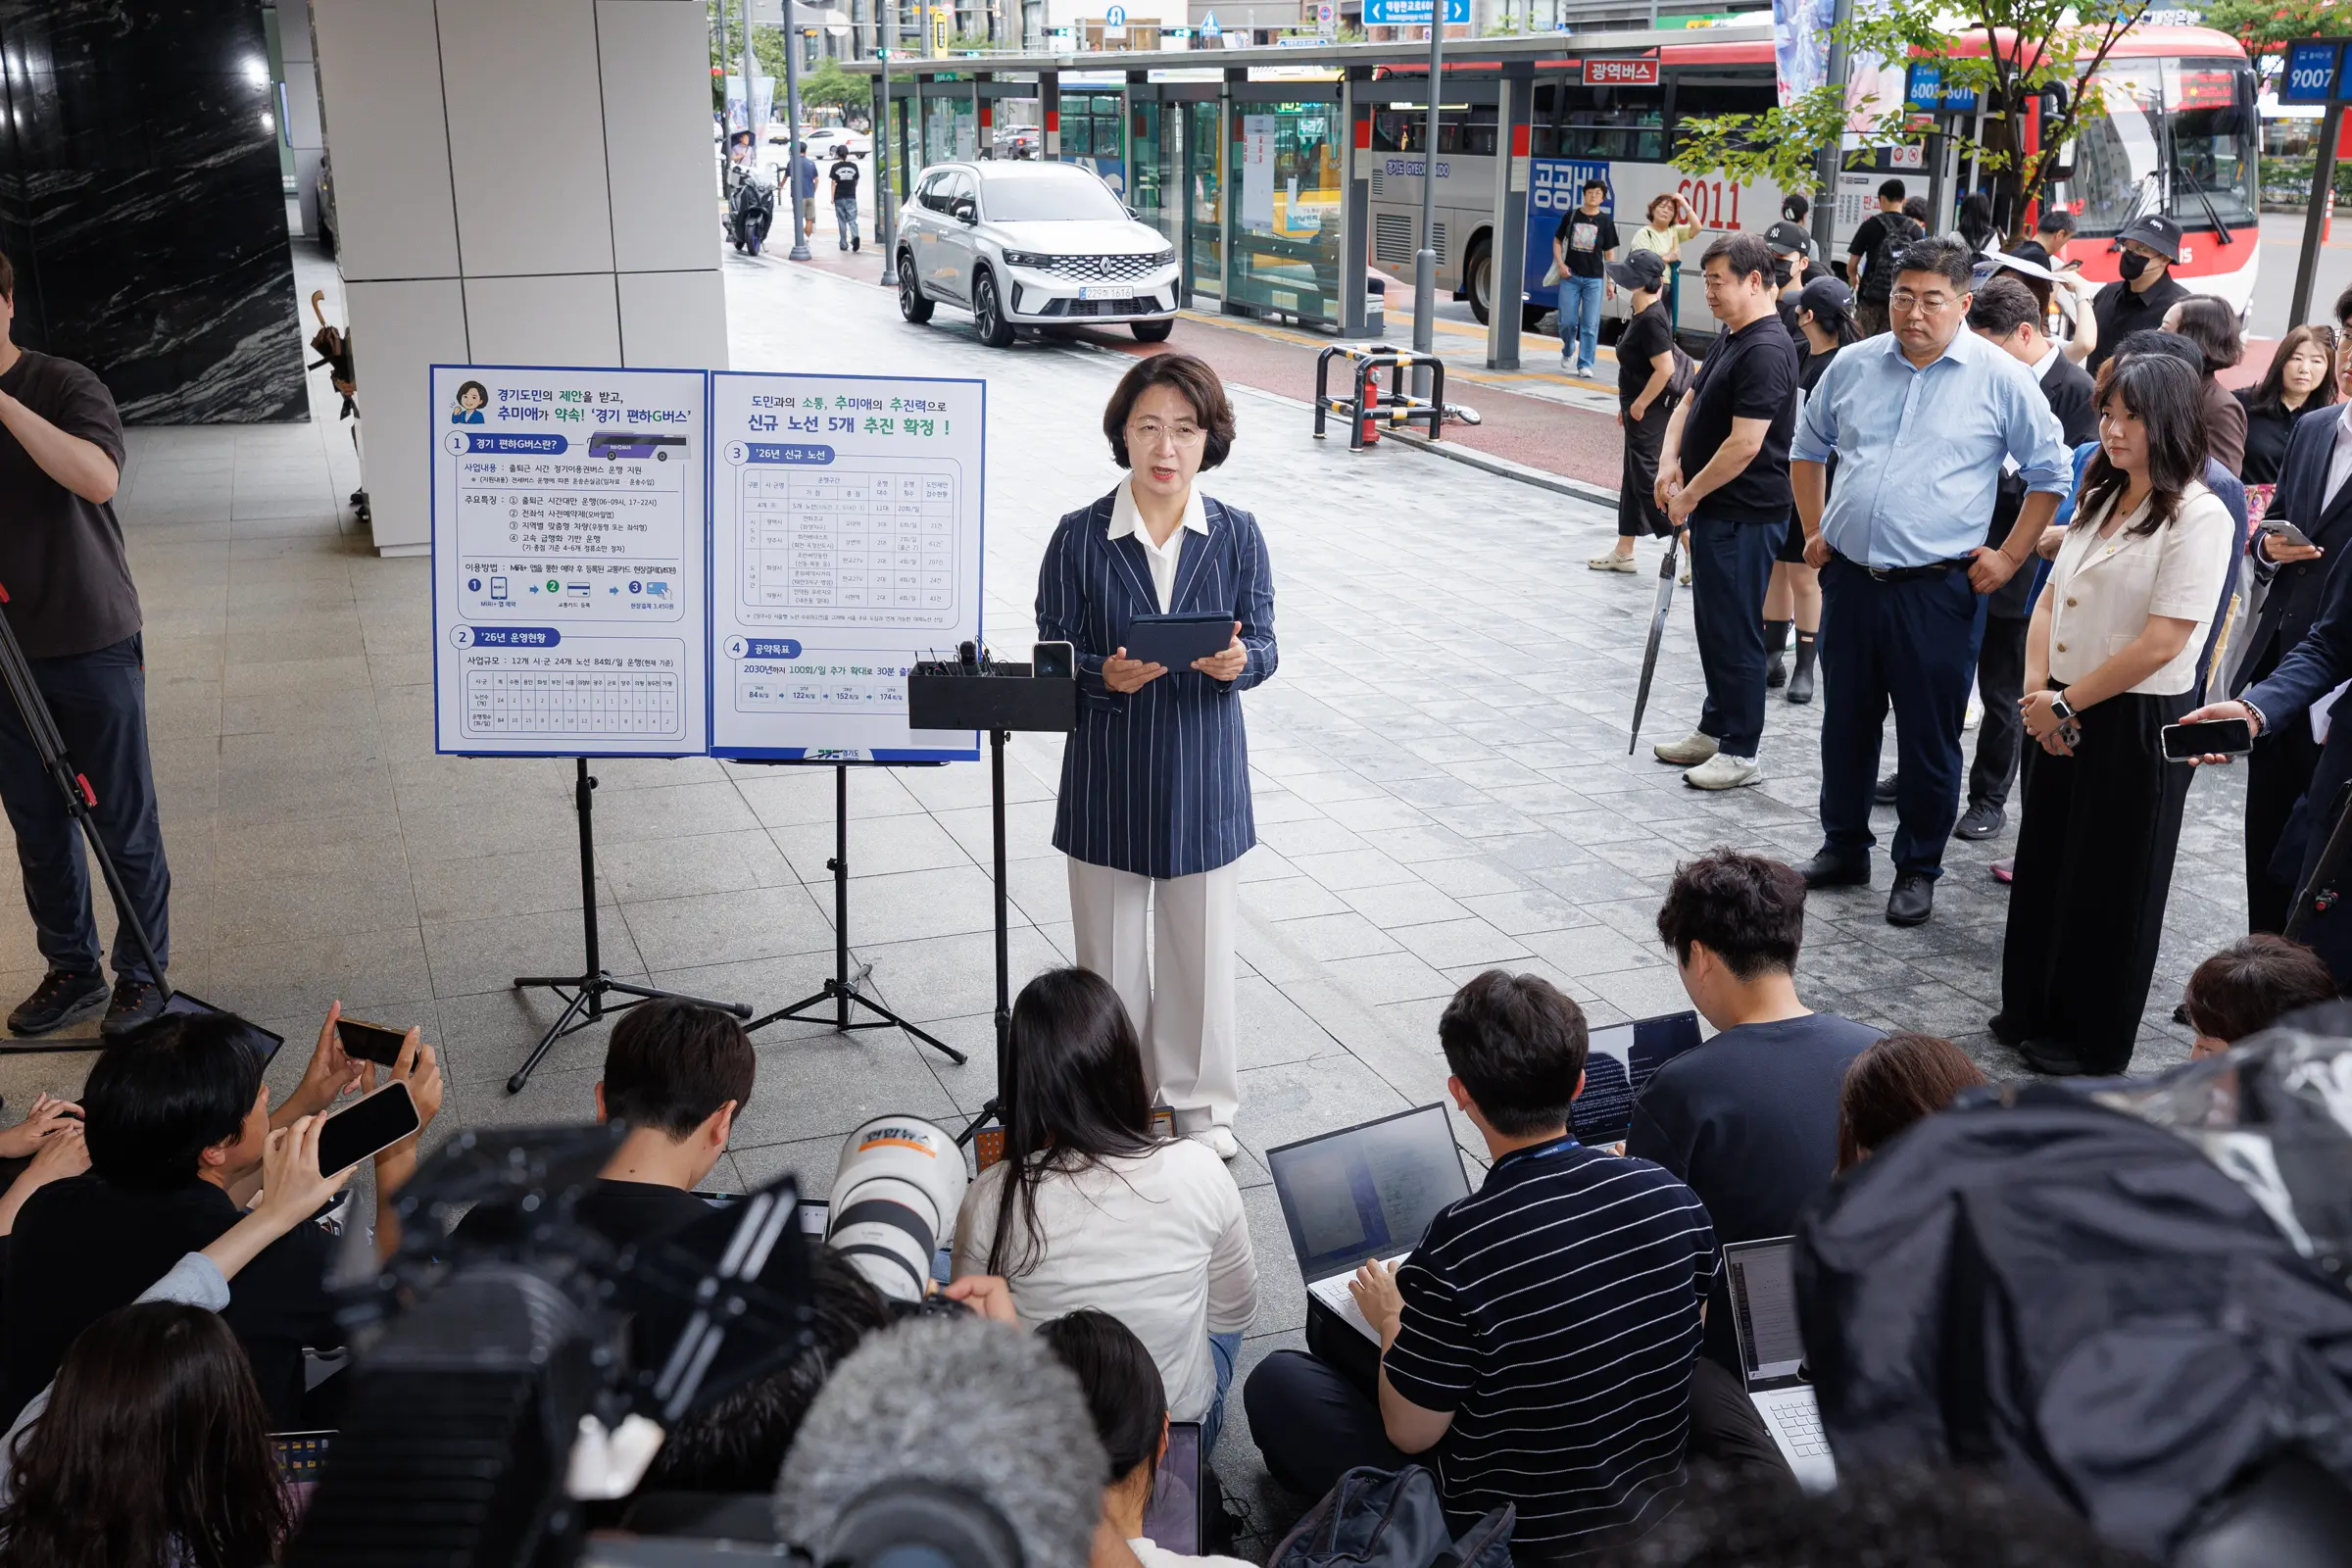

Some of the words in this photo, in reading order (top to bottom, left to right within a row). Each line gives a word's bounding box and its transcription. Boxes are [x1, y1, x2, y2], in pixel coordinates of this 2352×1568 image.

[1592, 63, 1650, 80] 광역버스
[2291, 69, 2334, 88] 9007
[1387, 161, 1404, 175] 경기도
[1406, 162, 1449, 177] GYEOIDO
[1677, 179, 1740, 230] 6011
[1111, 288, 1131, 298] 1616
[498, 389, 553, 402] 경기도민의
[560, 390, 593, 403] 제안을
[600, 391, 623, 404] 받고,
[752, 396, 795, 408] 도민과의
[803, 397, 827, 410] 소통,
[835, 396, 882, 411] 추미애의
[890, 397, 947, 413] 추진력으로
[498, 407, 549, 421] 추미애가
[555, 408, 584, 422] 약속!
[748, 415, 778, 432] 신규
[788, 416, 818, 432] 노선
[828, 416, 855, 433] 5개
[863, 417, 894, 434] 추진
[904, 418, 934, 436] 확정
[945, 420, 949, 435] !
[455, 438, 461, 448] 1
[476, 439, 493, 449] 경기
[500, 439, 557, 450] 편하G버스란?
[733, 448, 740, 459] 3
[785, 450, 802, 459] 신규
[808, 451, 825, 460] 노선
[465, 464, 496, 472] 사업내용
[510, 465, 530, 473] 출퇴근
[535, 465, 549, 473] 시간
[555, 466, 604, 474] 정기이용권버스
[609, 466, 622, 474] 운행
[465, 496, 497, 505] 주요특징
[549, 497, 577, 506] 시간대만
[549, 510, 614, 518] 사전예약제(모바일앱)
[548, 522, 570, 531] 맞춤형
[522, 534, 536, 543] 고속
[466, 564, 497, 572] 이용방법
[546, 564, 558, 573] 통한
[472, 581, 477, 590] 1
[550, 582, 556, 591] 2
[460, 632, 466, 642] 2
[511, 633, 546, 643] 운영현황
[733, 643, 740, 653] 4
[755, 644, 790, 655] 공약목표
[467, 657, 500, 665] 사업규모
[851, 666, 872, 675] 확대로
[877, 667, 895, 676] 30분
